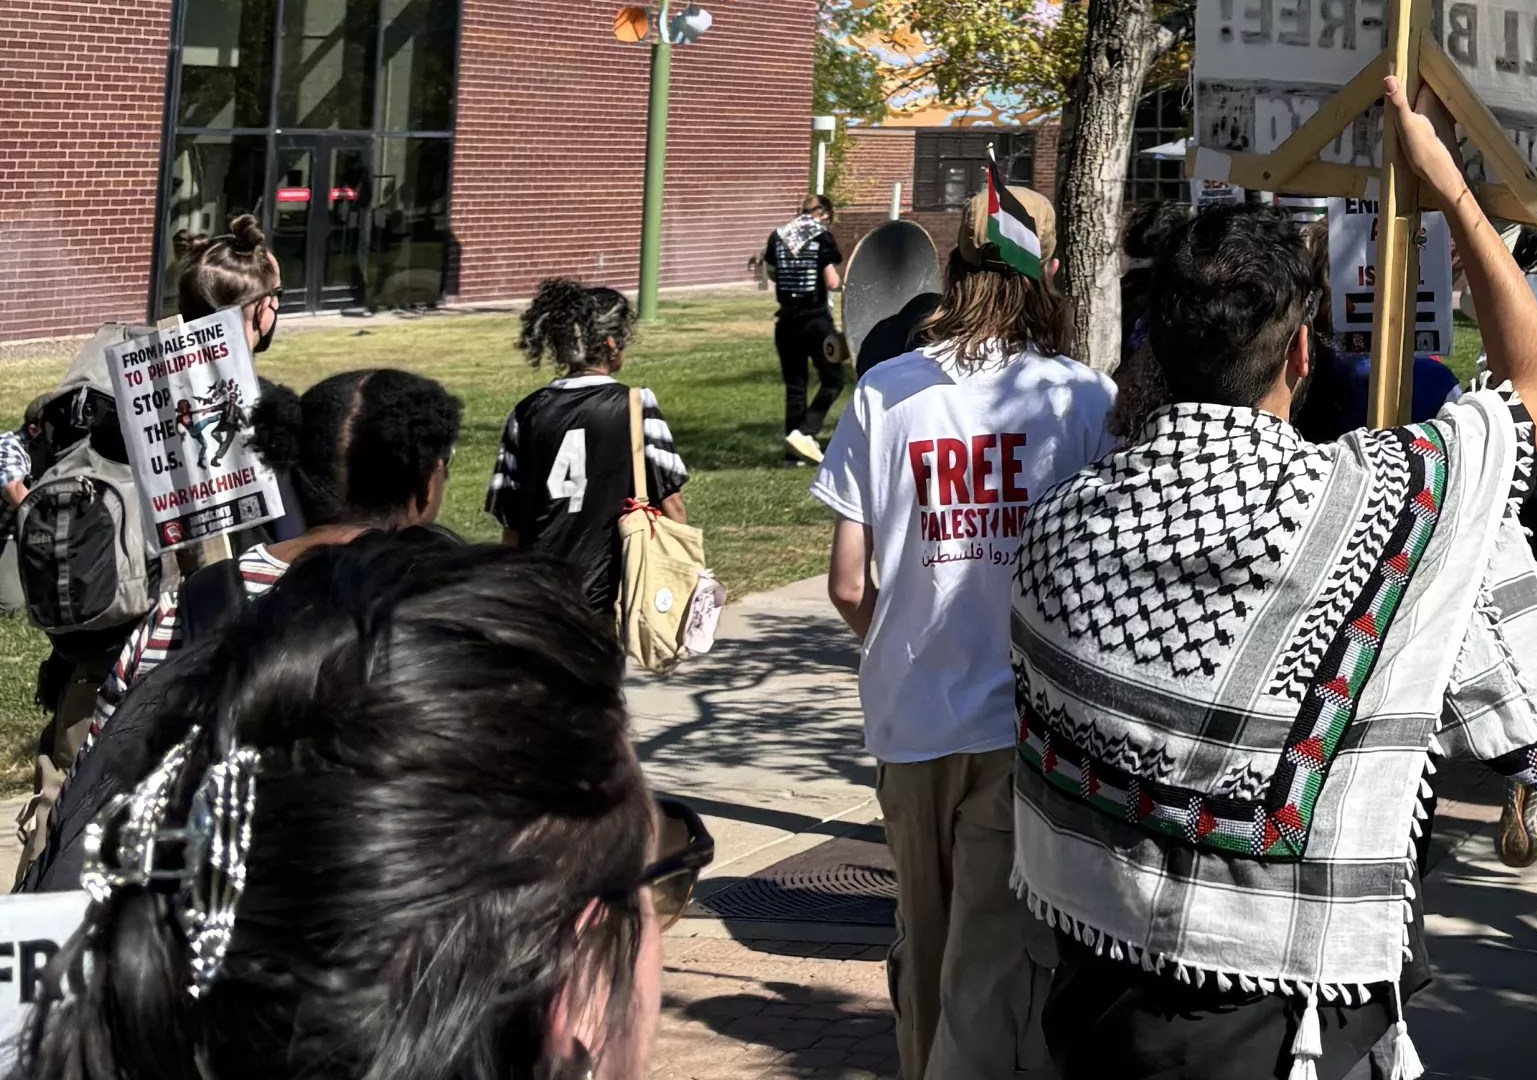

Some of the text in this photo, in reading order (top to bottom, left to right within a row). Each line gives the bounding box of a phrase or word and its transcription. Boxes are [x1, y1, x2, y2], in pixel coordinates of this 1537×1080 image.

[122, 345, 159, 368] FROM
[125, 341, 229, 388] TO PHILIPPINES
[132, 387, 171, 416] STOP
[144, 419, 176, 445] THE
[151, 451, 184, 475] U.S.
[547, 428, 588, 514] 4
[908, 433, 1029, 507] FREE
[152, 466, 257, 513] WAR MACHINE!
[922, 542, 984, 568] فلسطين
